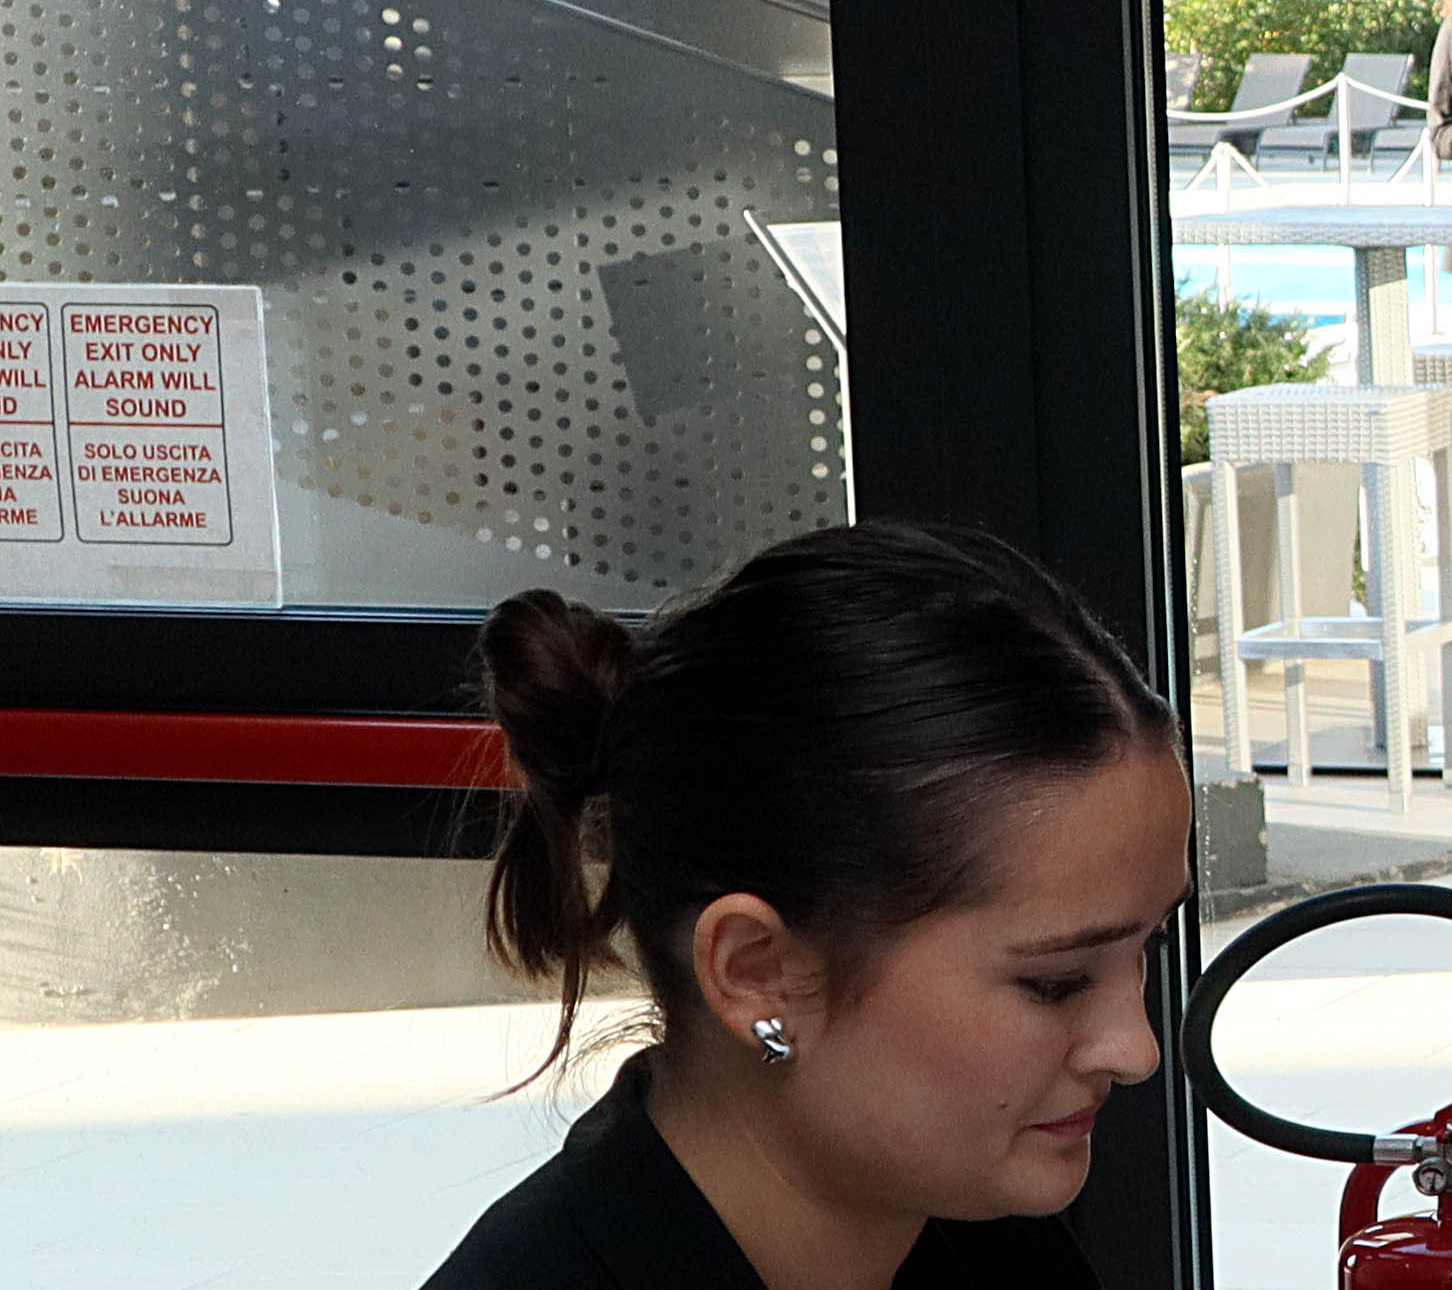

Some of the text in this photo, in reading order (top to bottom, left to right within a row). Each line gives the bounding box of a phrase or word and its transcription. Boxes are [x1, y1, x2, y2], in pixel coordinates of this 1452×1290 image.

[70, 314, 214, 334] EMERGENCY
[86, 342, 201, 362] EXIT ONLY
[74, 370, 216, 390] ALARM WILL
[106, 398, 187, 418] SOUND
[84, 443, 212, 461] SOLO USCITA
[0, 464, 53, 481] ENZA
[78, 466, 222, 484] DI EMERGENZA
[118, 488, 185, 505] SUONA
[100, 510, 207, 528] L'ALLARME
